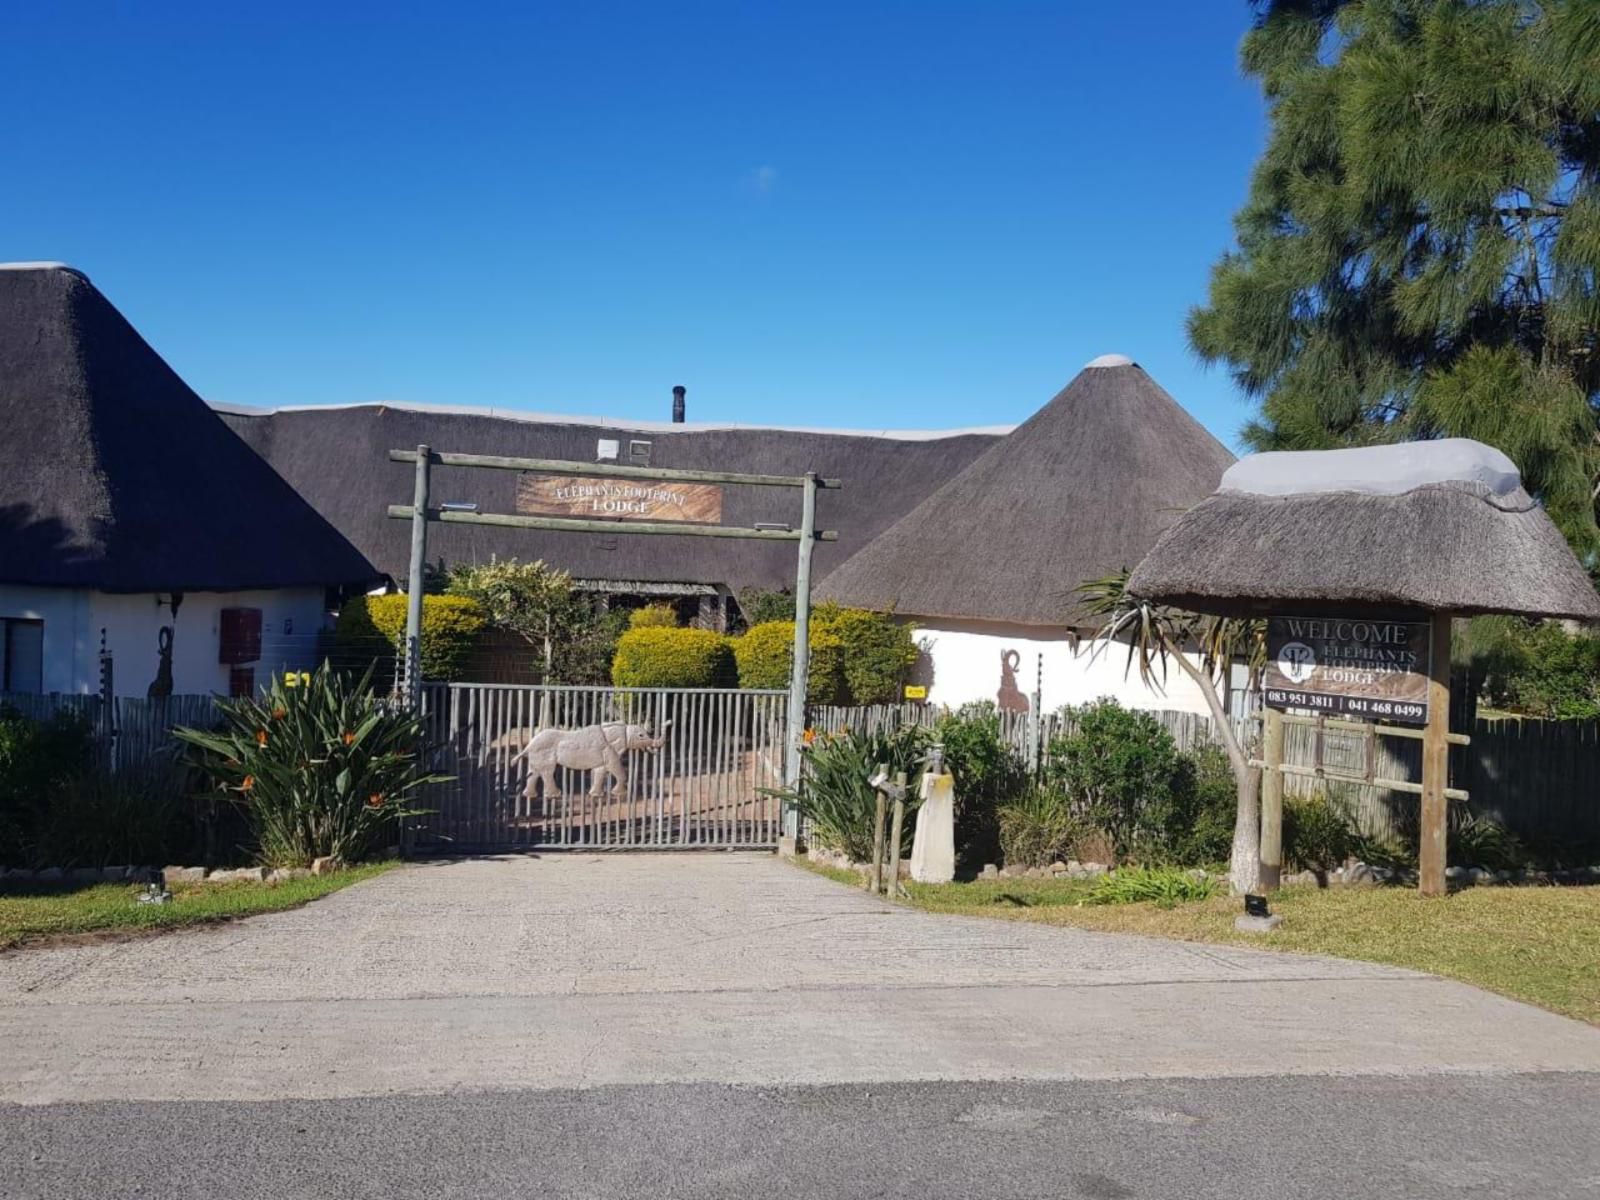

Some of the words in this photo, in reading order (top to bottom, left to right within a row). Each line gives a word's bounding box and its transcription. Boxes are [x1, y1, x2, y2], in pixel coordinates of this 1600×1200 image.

[624, 487, 688, 506] FOOTPRINT
[592, 499, 649, 513] LODGE
[1288, 620, 1408, 645] WELCOME
[1324, 646, 1417, 663] ELEPHANTS
[1324, 657, 1416, 675] FOOTPRINT
[1323, 670, 1375, 684] LODGE
[1268, 690, 1287, 702] 083
[1289, 693, 1306, 704] 951
[1309, 696, 1333, 708] 3811
[1348, 699, 1368, 712] 041
[1371, 702, 1392, 714] 468
[1394, 704, 1423, 717] 0499
